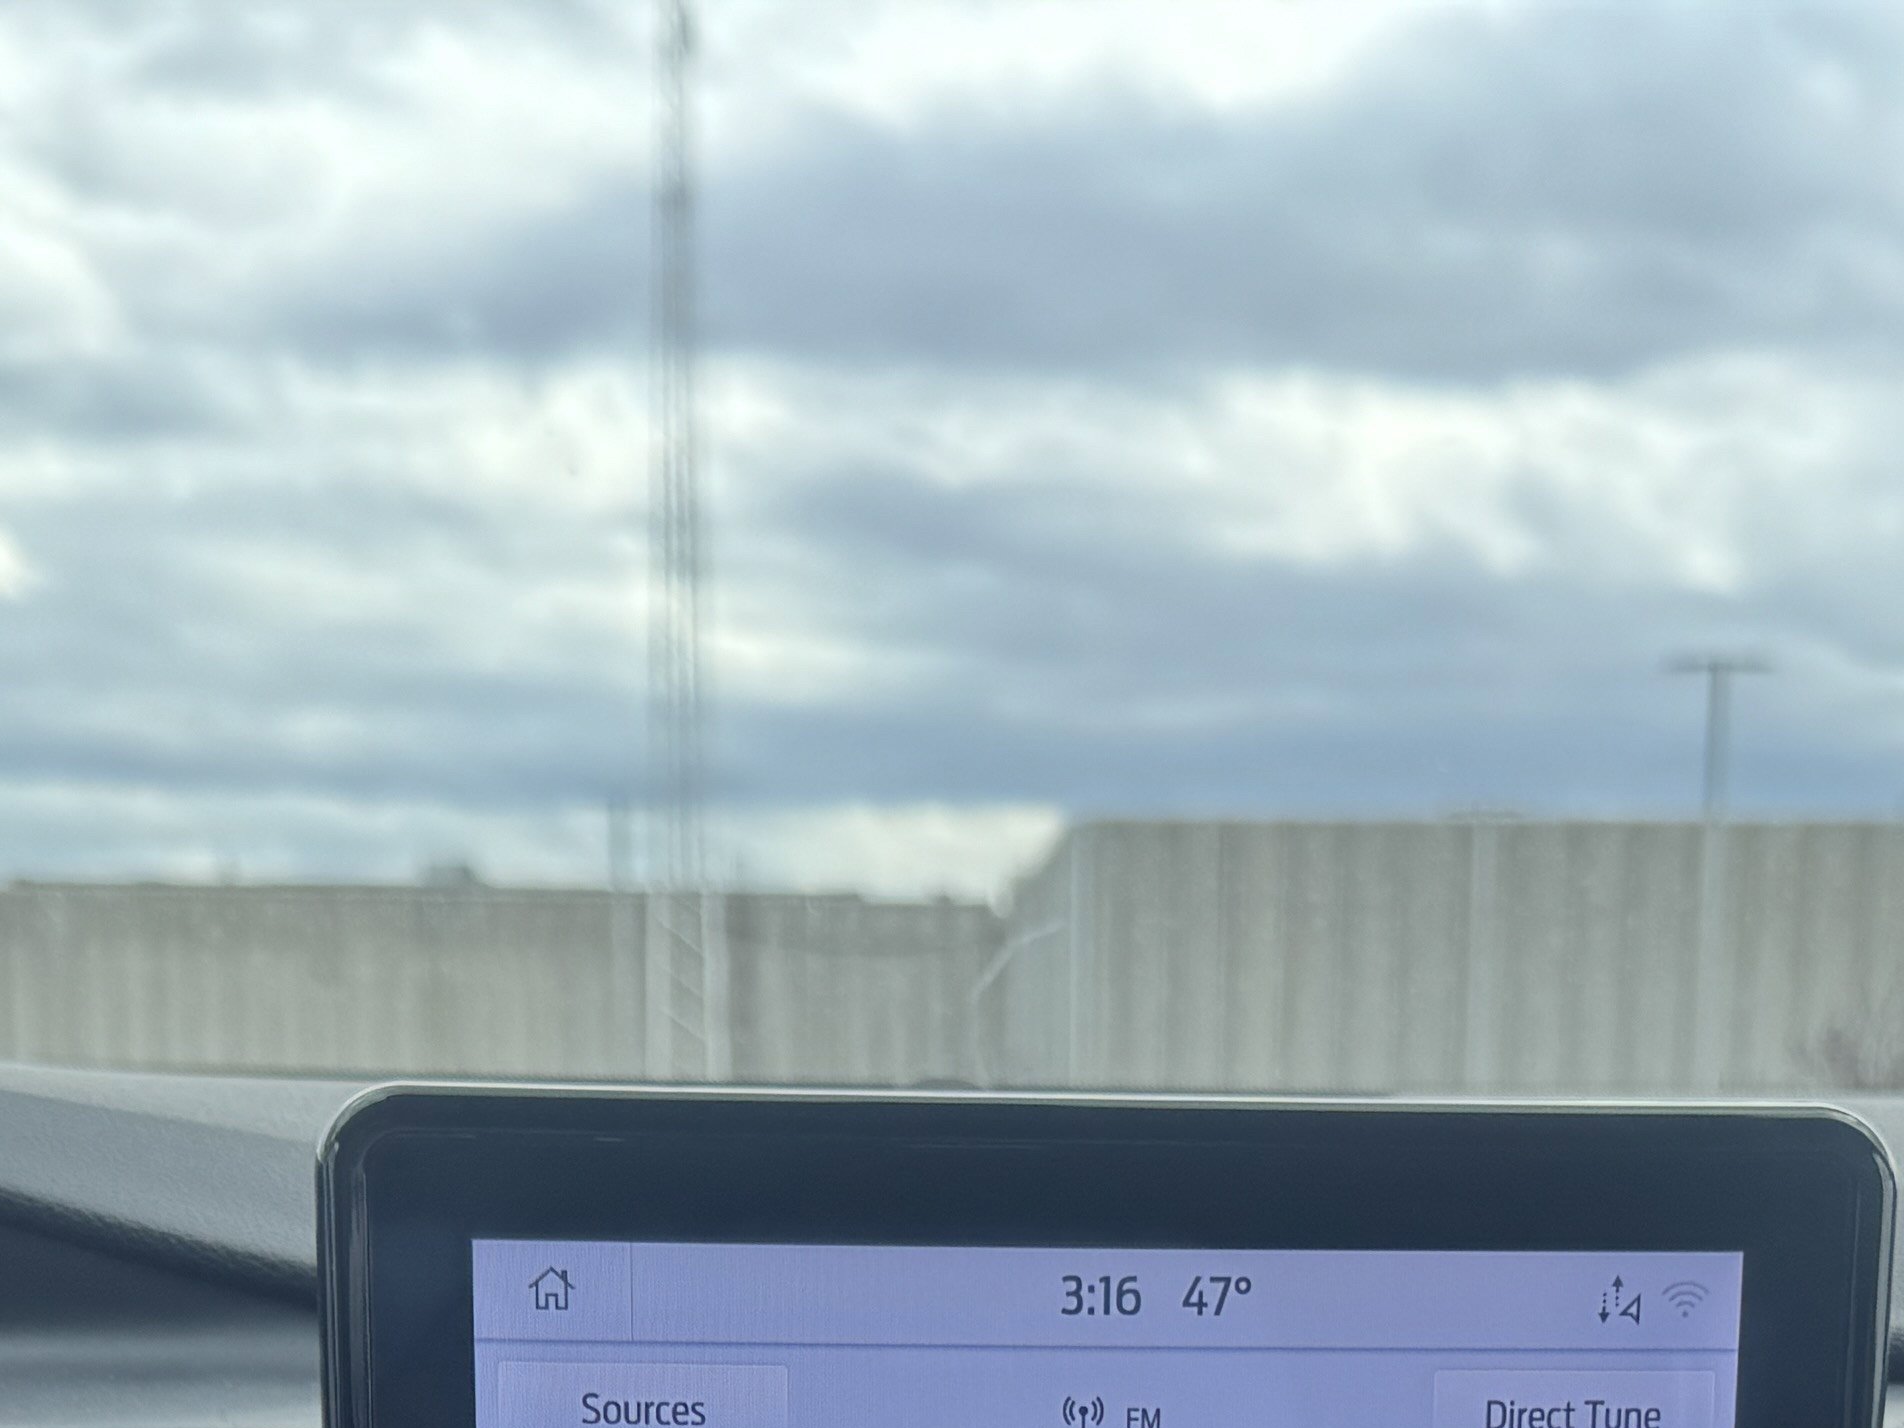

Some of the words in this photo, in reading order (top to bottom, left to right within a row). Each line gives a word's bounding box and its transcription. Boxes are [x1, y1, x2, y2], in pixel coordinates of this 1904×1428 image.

[1060, 1274, 1142, 1316] 3:16
[1182, 1275, 1252, 1317] 47°
[581, 1392, 706, 1426] Sources
